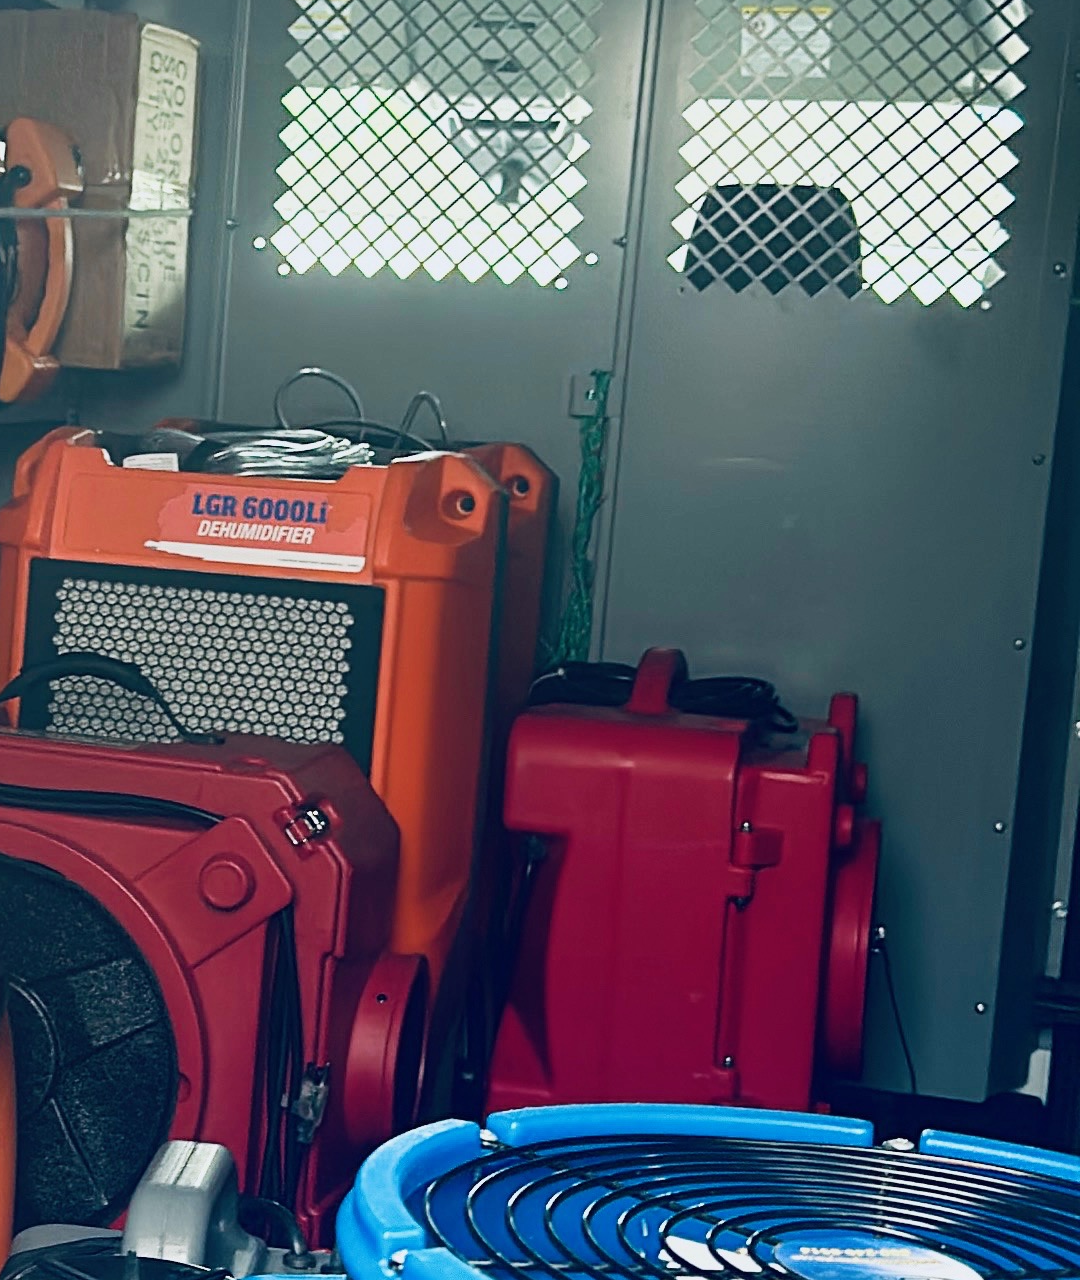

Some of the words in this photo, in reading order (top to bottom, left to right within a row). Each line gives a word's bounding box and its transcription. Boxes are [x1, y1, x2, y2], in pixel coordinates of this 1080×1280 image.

[192, 492, 238, 517] LGR
[242, 496, 328, 524] 6000Li
[197, 519, 316, 545] DEHUMIDIFIER
